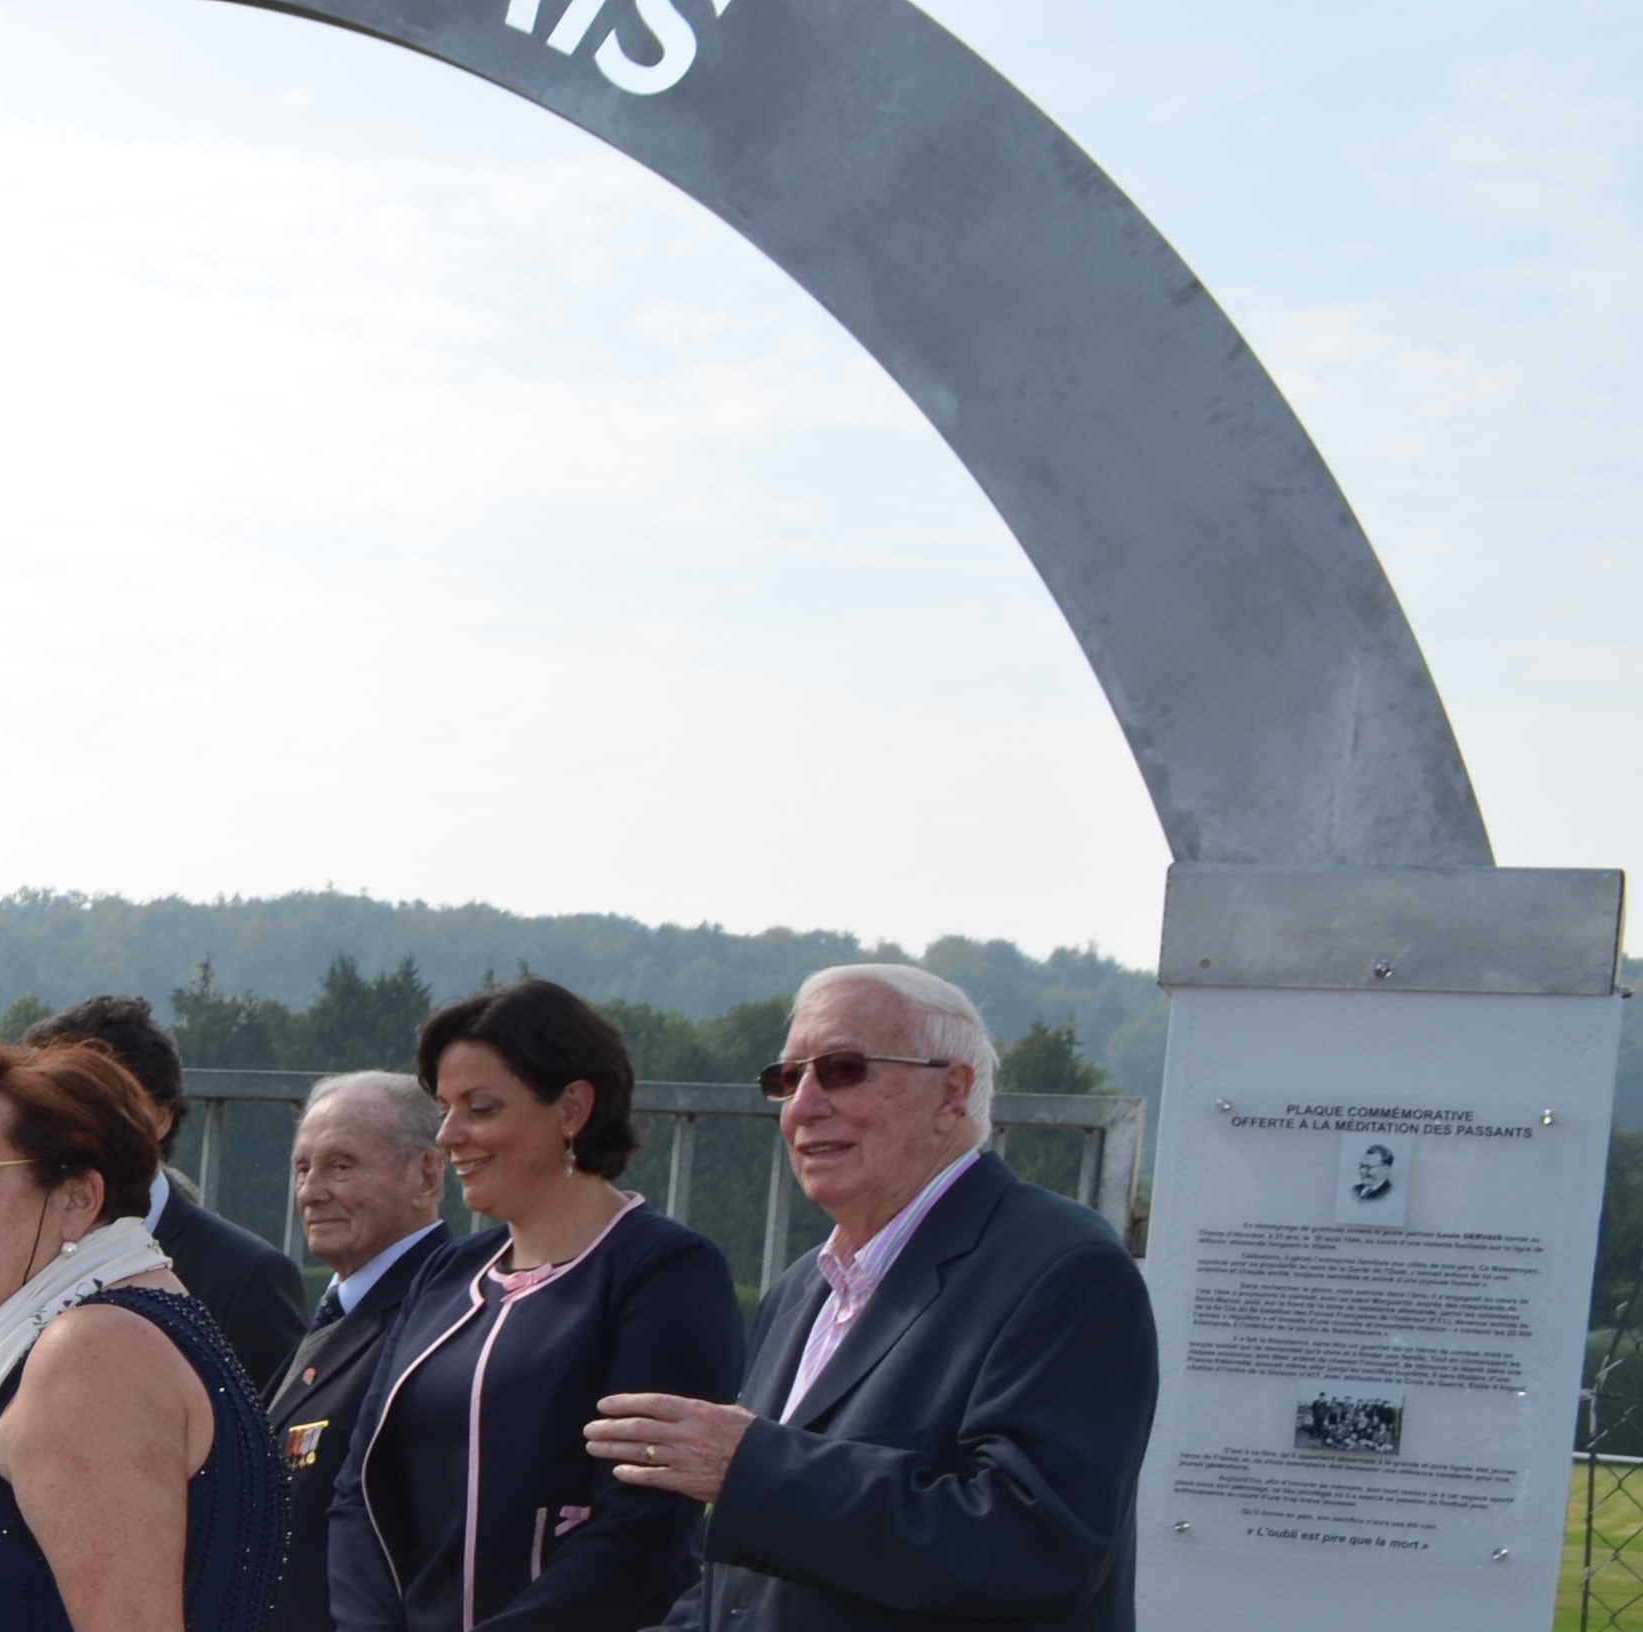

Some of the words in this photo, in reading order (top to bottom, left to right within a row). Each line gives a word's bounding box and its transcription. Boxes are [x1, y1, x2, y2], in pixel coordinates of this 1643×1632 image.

[1285, 1104, 1342, 1116] PLAQUE
[1347, 1105, 1473, 1121] COMMÉMORATIVE
[1230, 1116, 1293, 1128] OFFERTE
[1298, 1118, 1308, 1128] À
[1312, 1120, 1330, 1130] LA
[1334, 1119, 1419, 1133] MÉDITATION
[1422, 1123, 1452, 1135] DES
[1455, 1124, 1532, 1138] PASSANTS
[1462, 1232, 1502, 1240] GERVAIS
[1256, 1527, 1298, 1539] L'oubli
[1300, 1532, 1319, 1541] est
[1321, 1534, 1345, 1545] pire
[1348, 1536, 1372, 1547] que
[1374, 1536, 1386, 1546] la
[1389, 1539, 1419, 1549] mort
